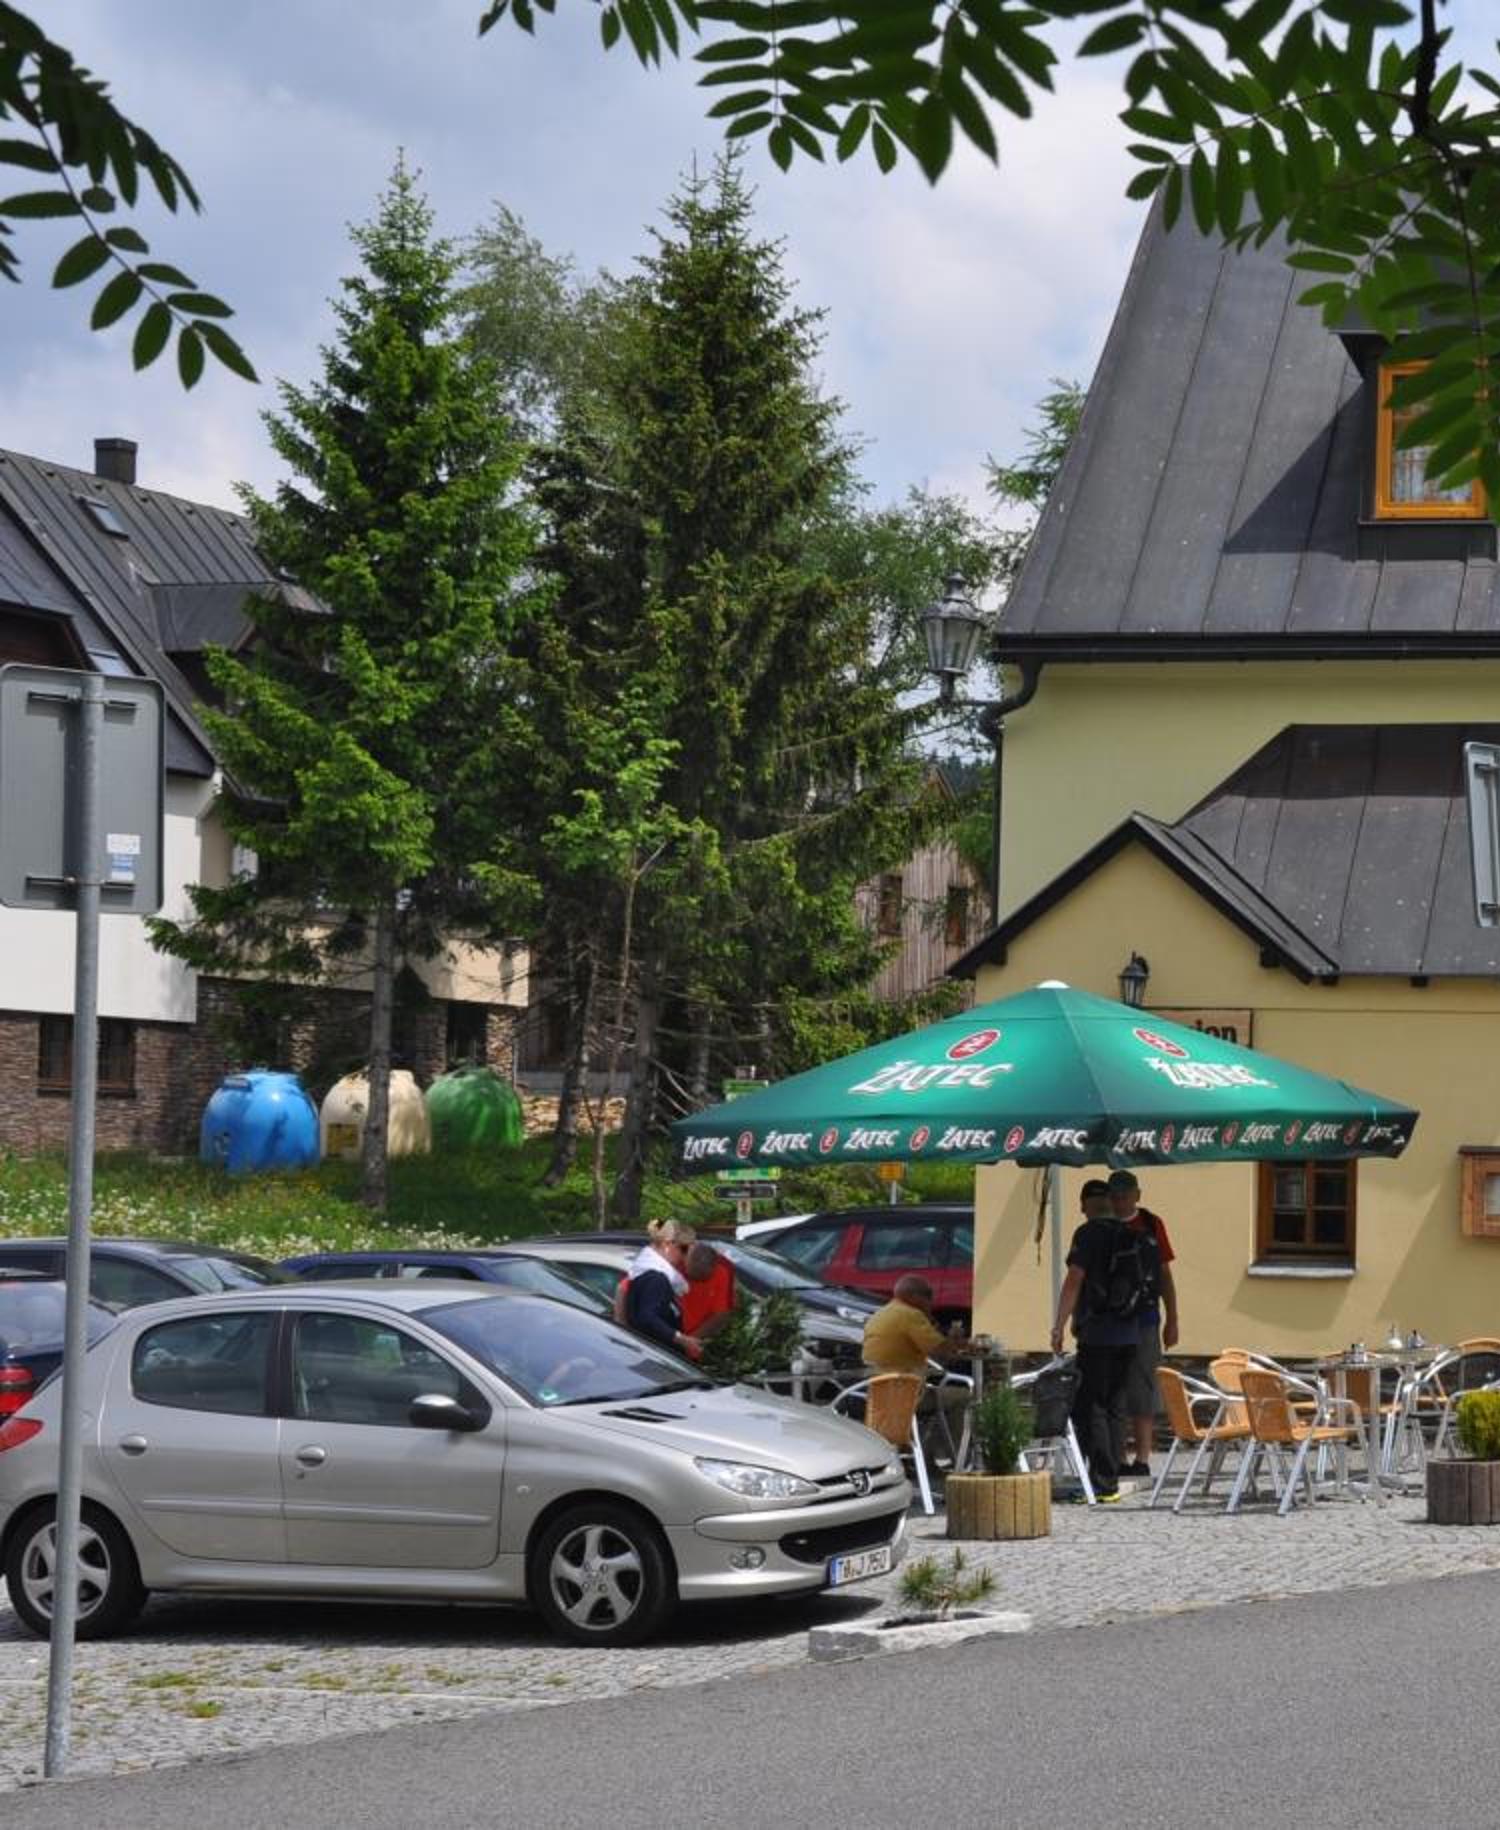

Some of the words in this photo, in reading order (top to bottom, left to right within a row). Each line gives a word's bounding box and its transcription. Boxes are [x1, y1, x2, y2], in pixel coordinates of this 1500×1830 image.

[848, 1060, 1015, 1095] ŽATEC
[760, 1129, 813, 1154] ŽATEC
[844, 1128, 900, 1150] ŽATEC
[936, 1125, 996, 1150] ŽATEC
